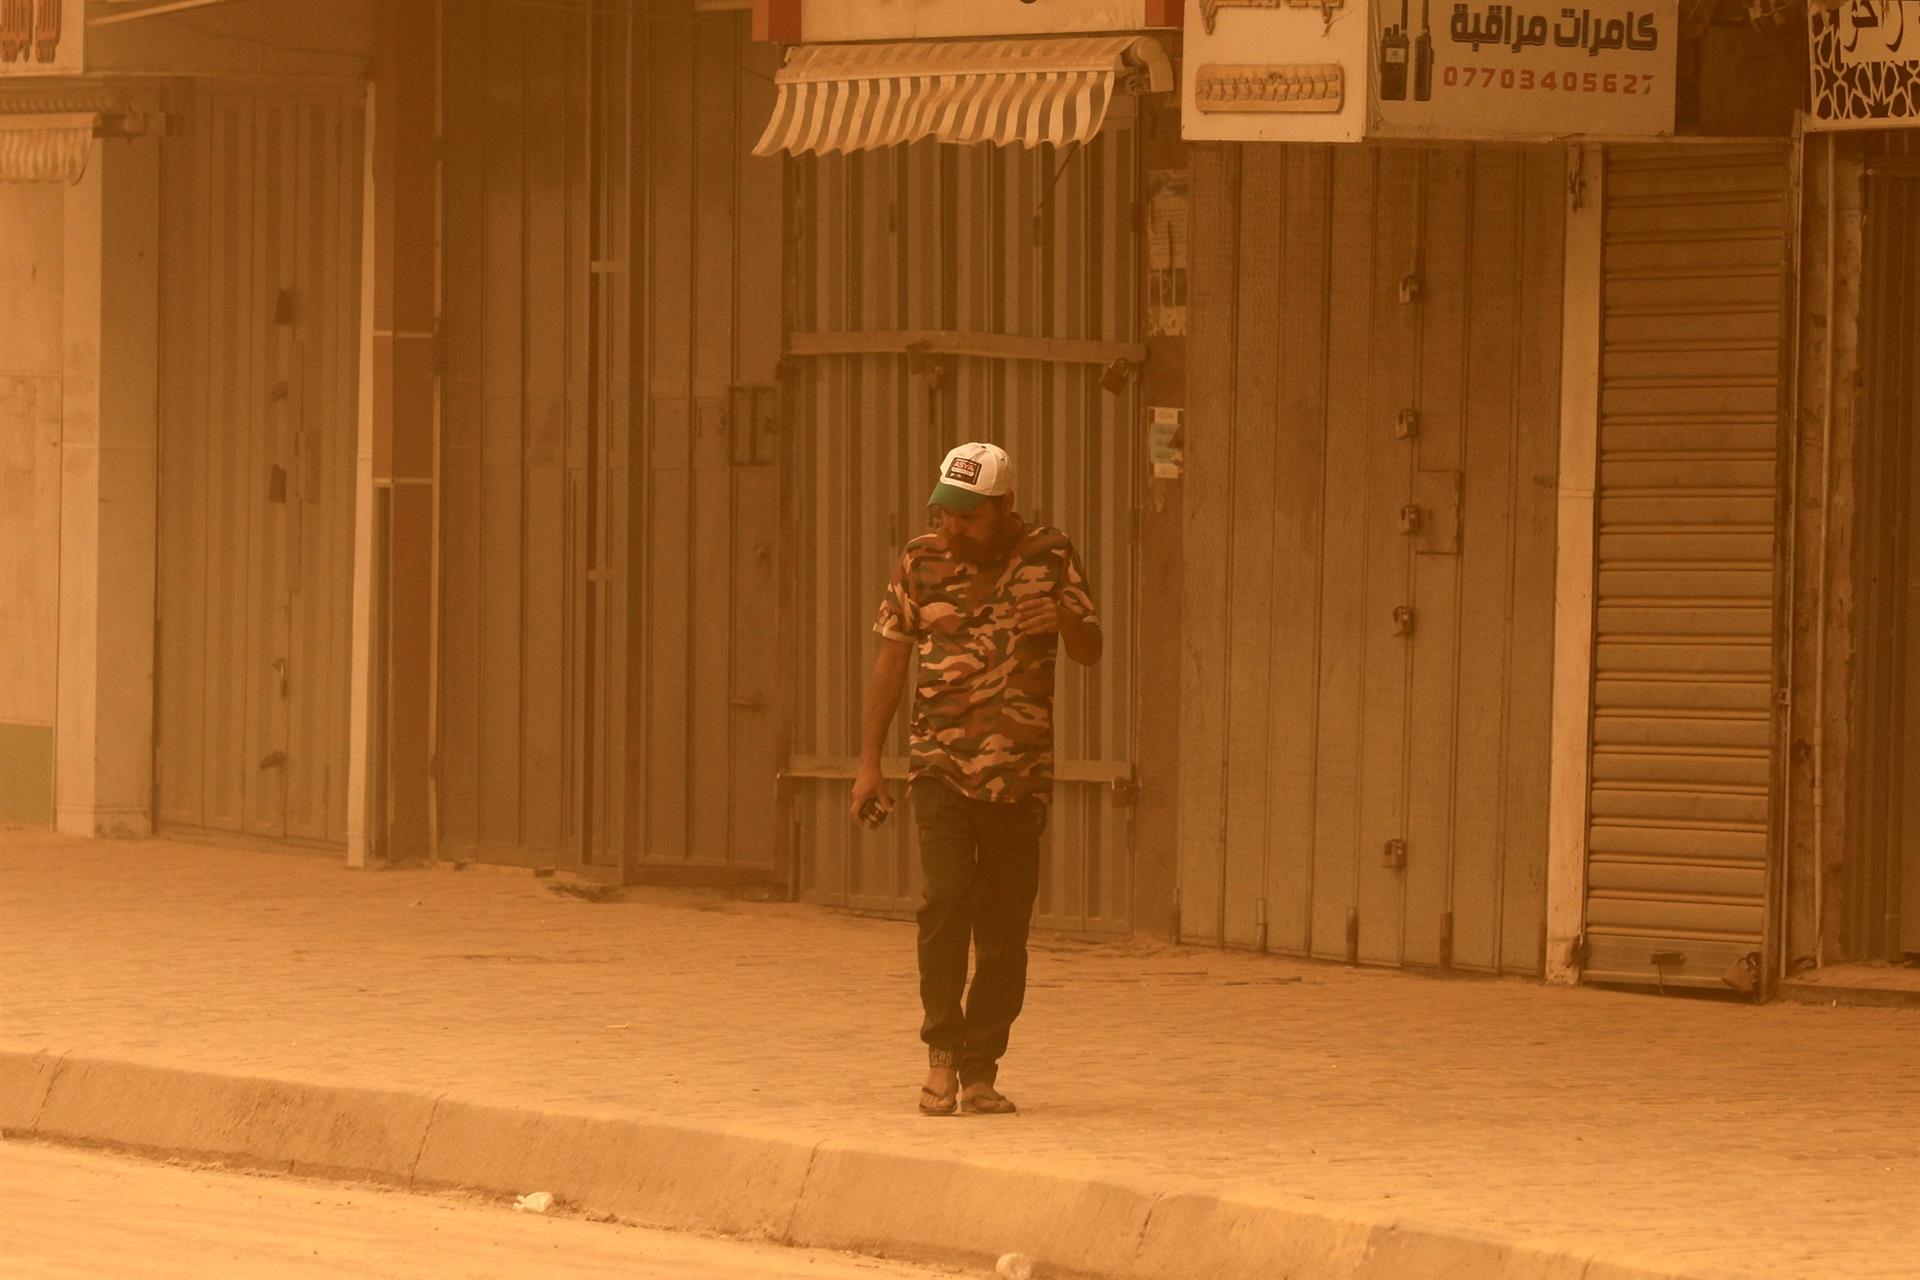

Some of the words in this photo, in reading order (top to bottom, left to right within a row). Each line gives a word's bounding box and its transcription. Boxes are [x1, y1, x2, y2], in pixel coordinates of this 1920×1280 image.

[1450, 3, 1548, 53] مراقبة
[1553, 8, 1658, 56] كامرات
[1442, 65, 1656, 95] 07703405627
